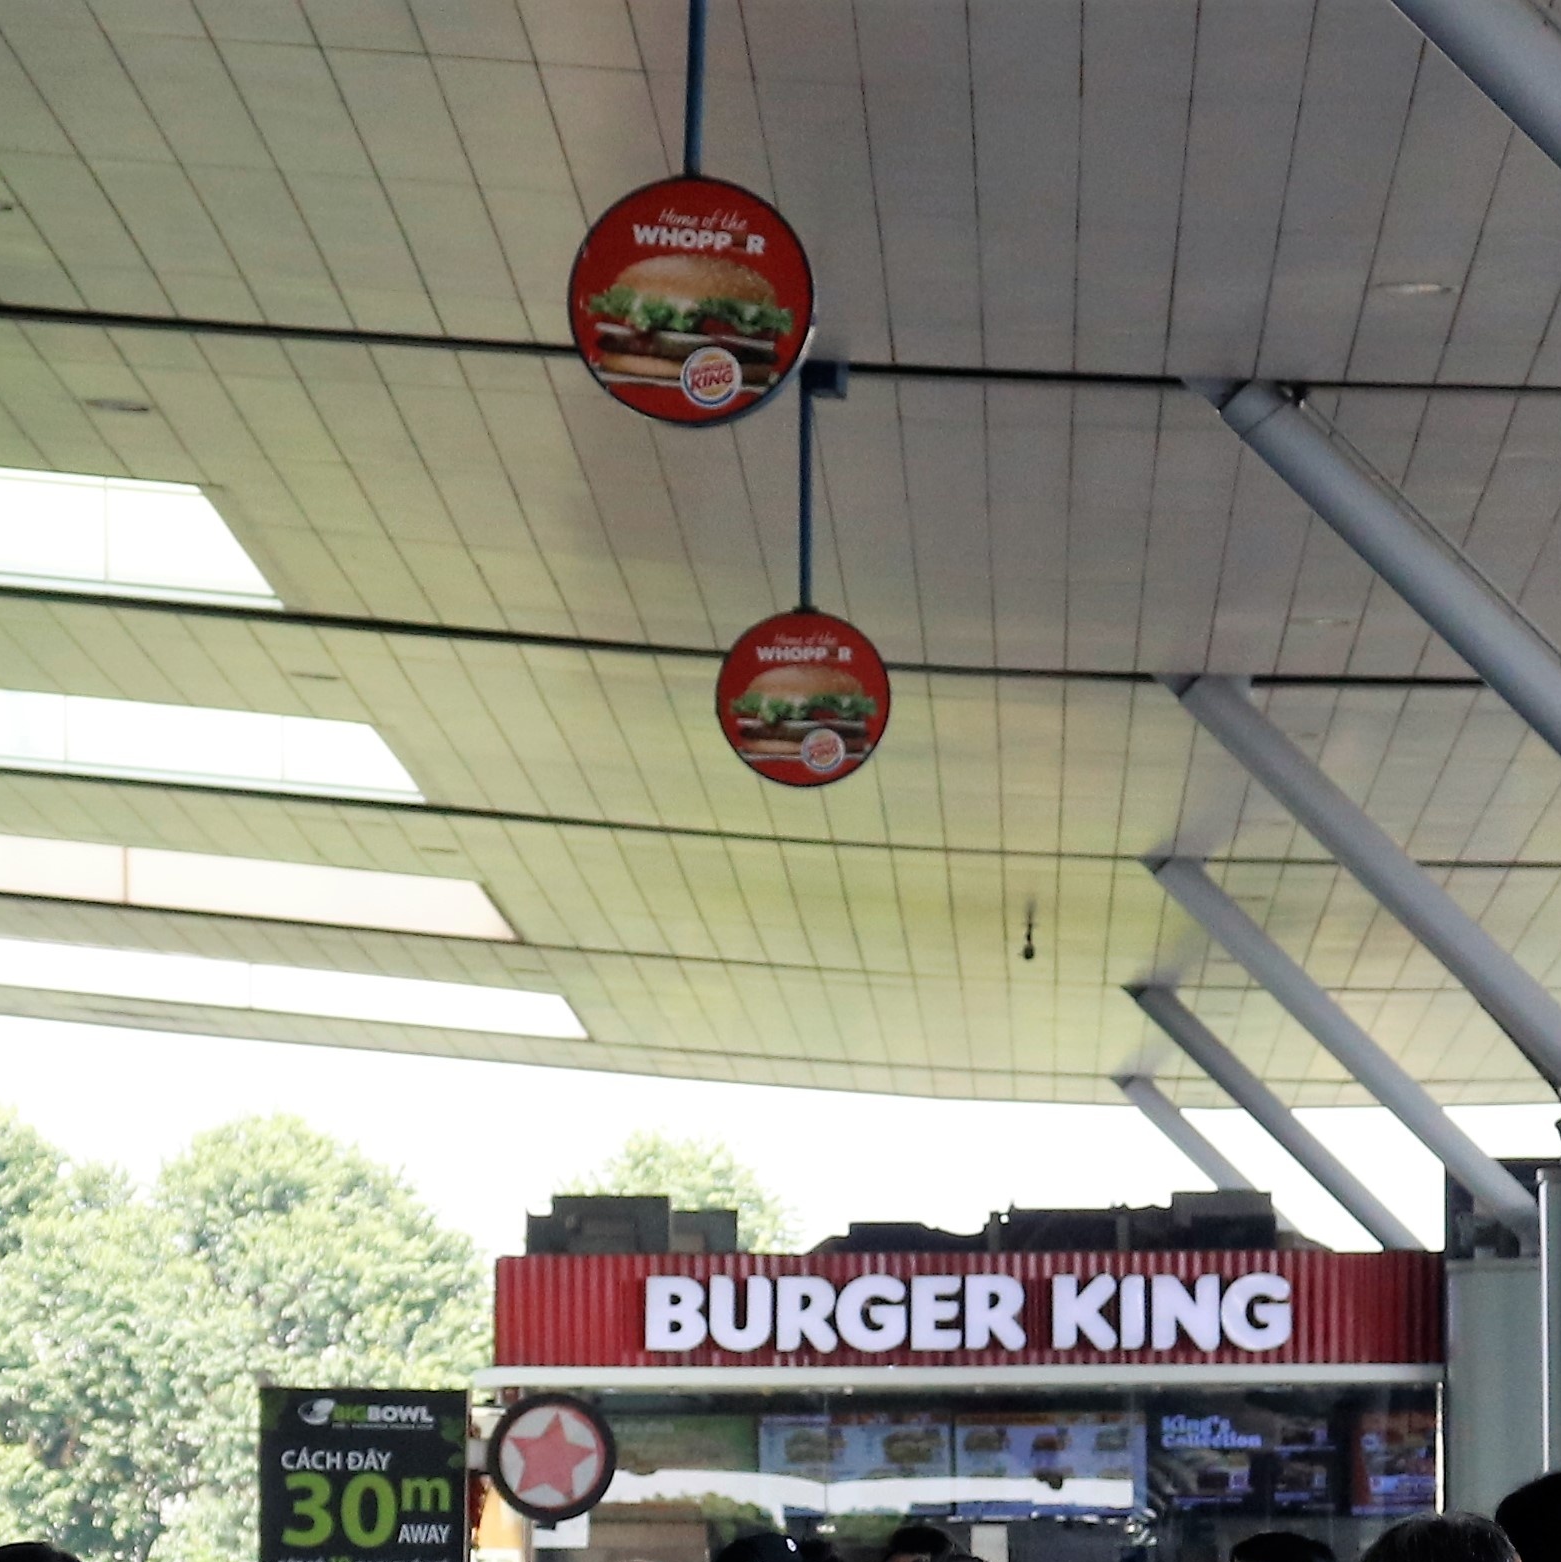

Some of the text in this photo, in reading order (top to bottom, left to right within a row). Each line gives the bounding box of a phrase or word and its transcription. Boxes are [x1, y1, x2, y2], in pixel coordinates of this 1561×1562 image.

[658, 207, 748, 230] Home of the
[689, 367, 734, 390] KING
[644, 1271, 1292, 1354] BURGER KING
[281, 1447, 392, 1471] CÁCH ĐÂY
[398, 1524, 451, 1544] AWAY
